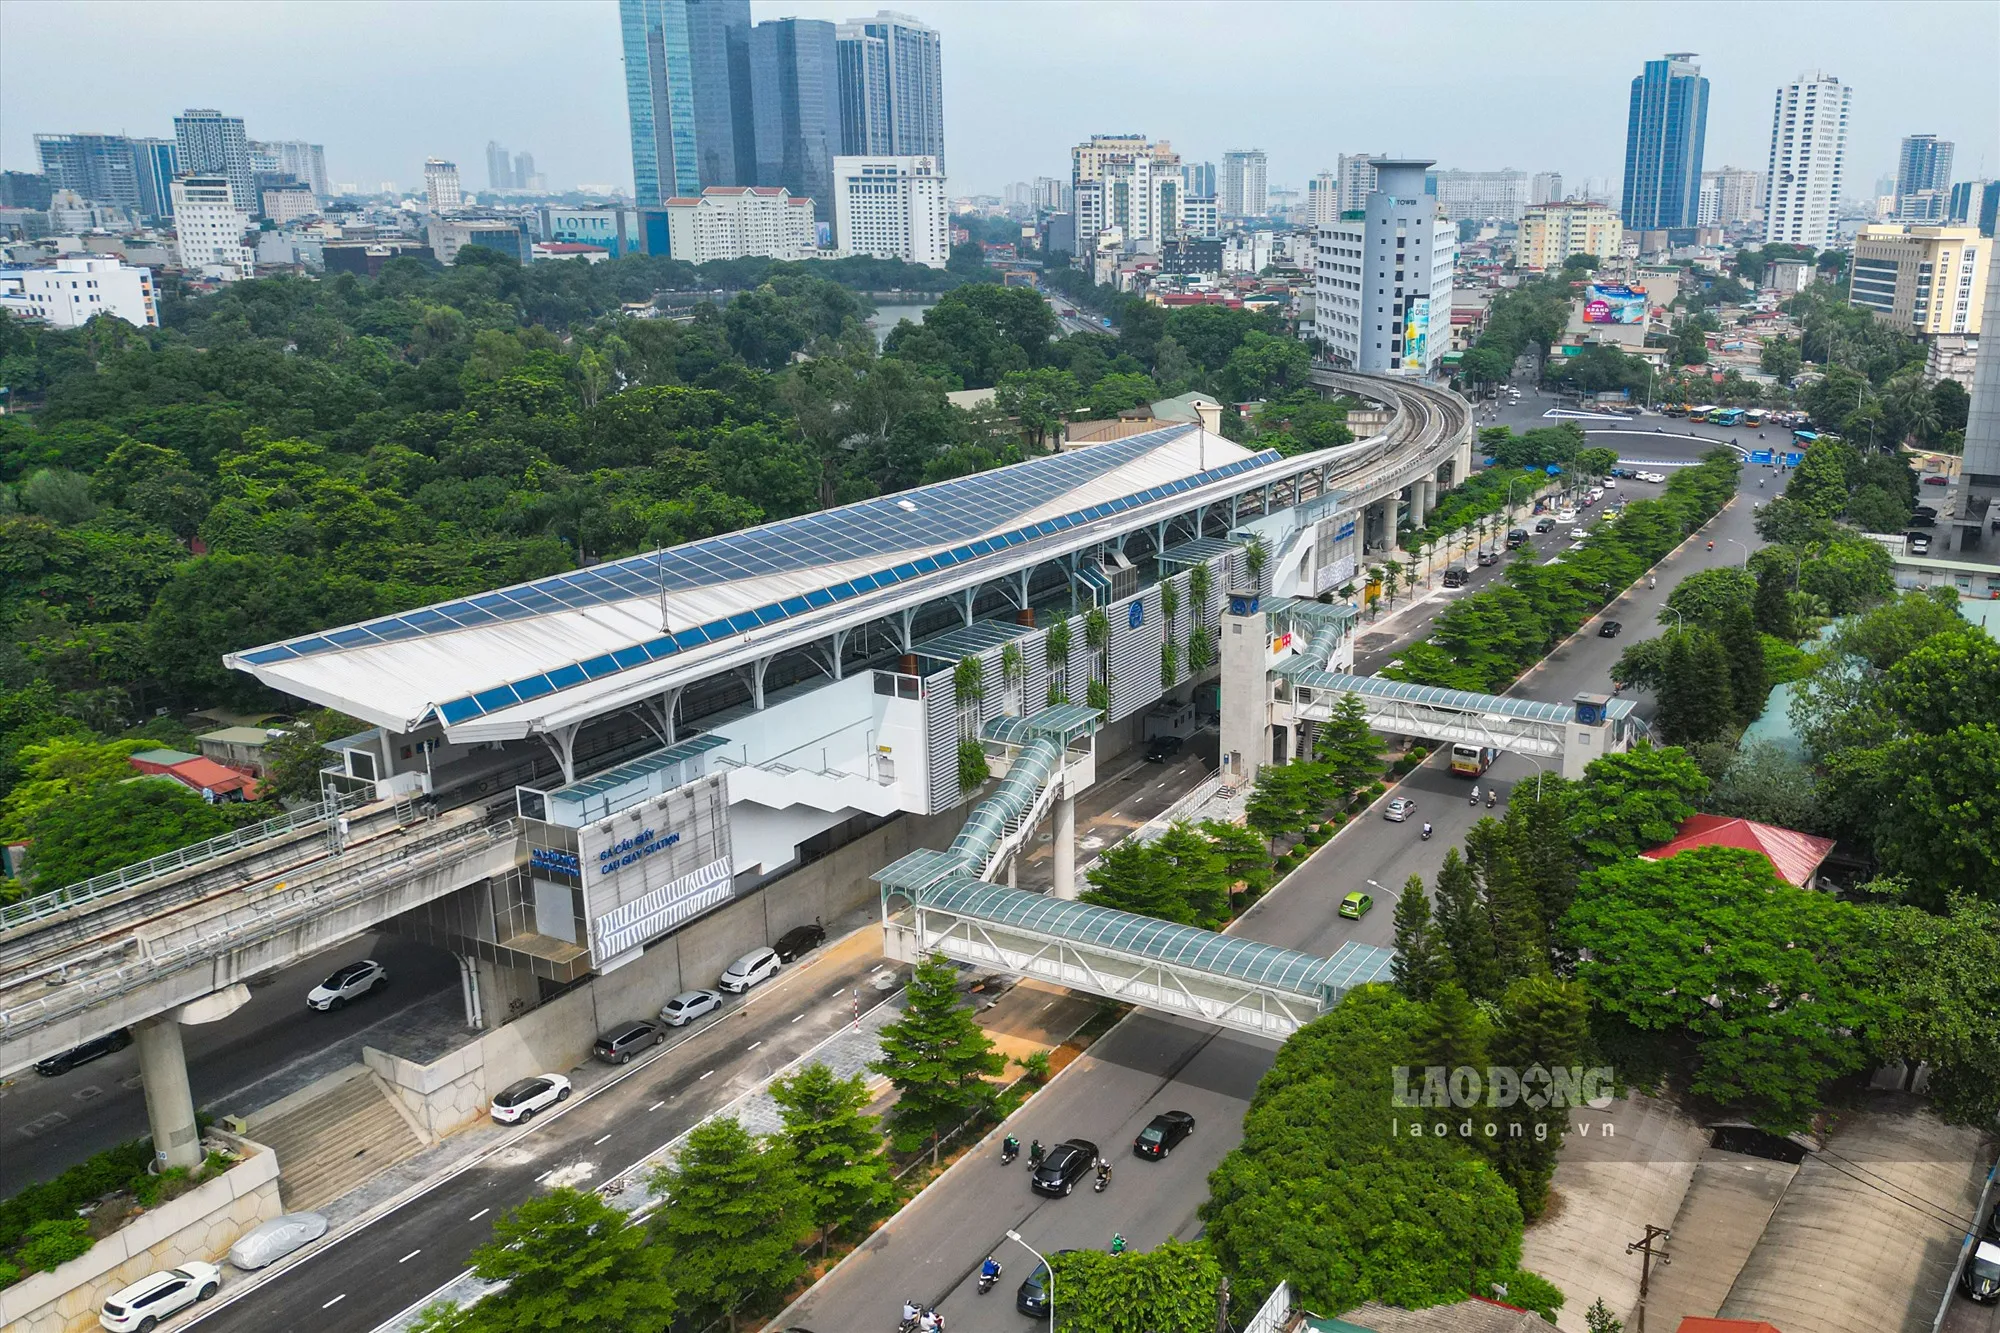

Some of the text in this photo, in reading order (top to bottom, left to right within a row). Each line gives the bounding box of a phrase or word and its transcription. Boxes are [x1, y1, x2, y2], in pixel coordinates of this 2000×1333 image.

[557, 217, 609, 230] LOTTE
[600, 848, 613, 861] GA
[614, 838, 633, 855] CẦU
[601, 832, 680, 875] CAU GIAY STATION
